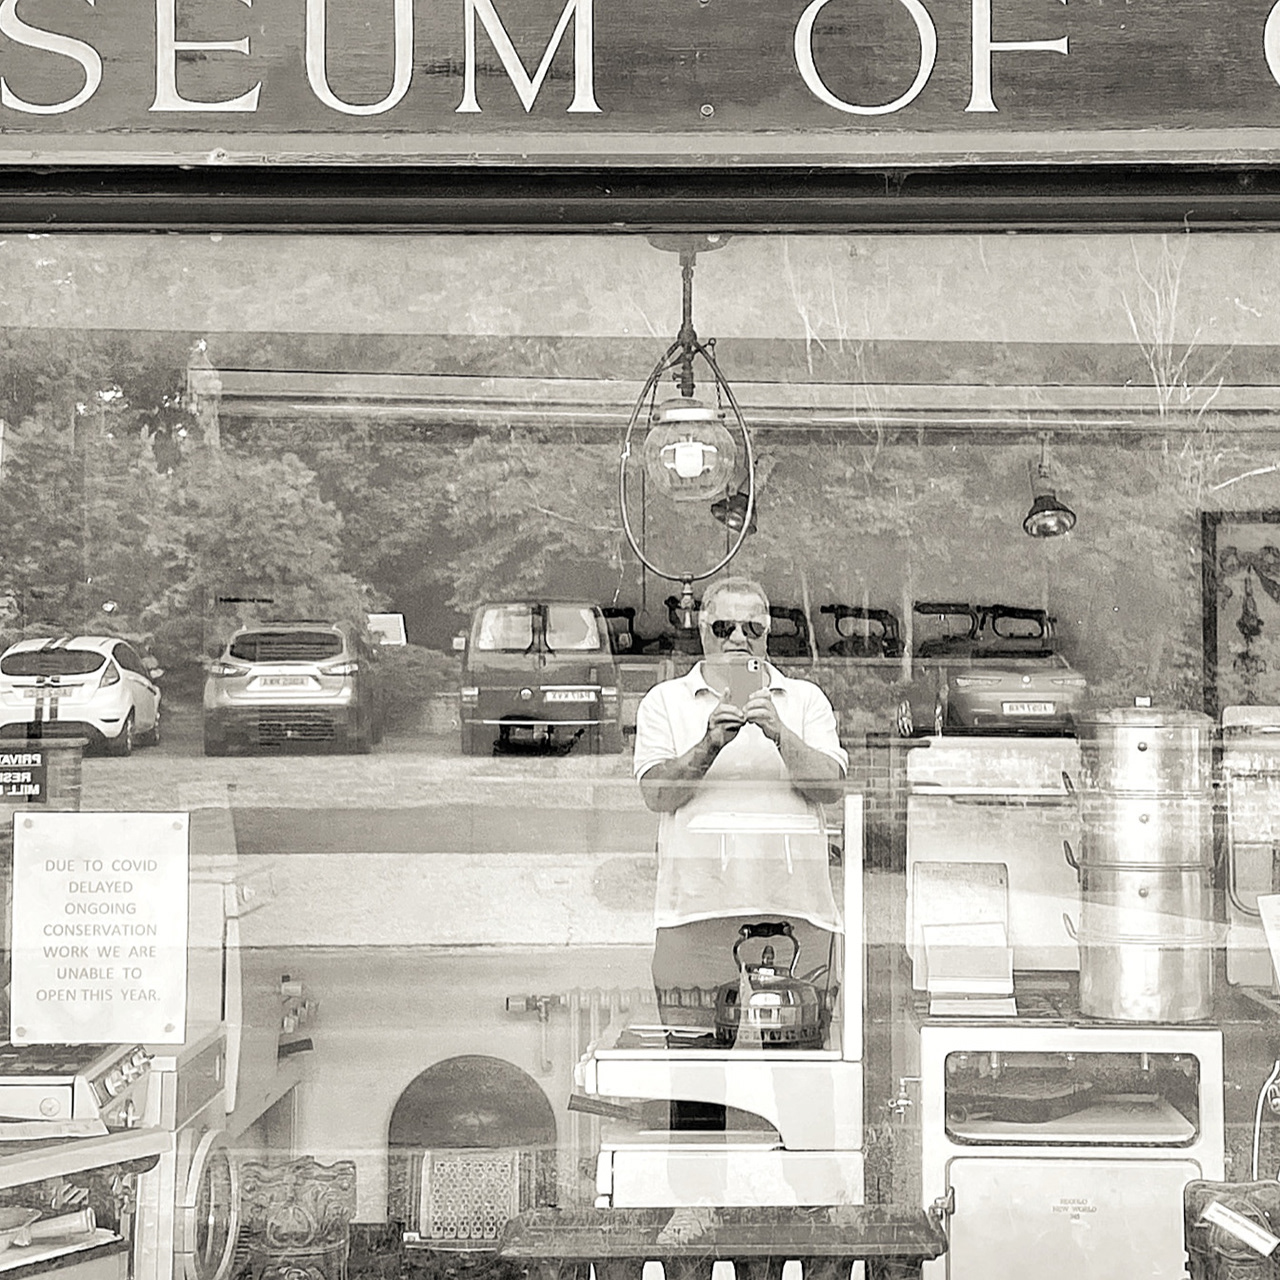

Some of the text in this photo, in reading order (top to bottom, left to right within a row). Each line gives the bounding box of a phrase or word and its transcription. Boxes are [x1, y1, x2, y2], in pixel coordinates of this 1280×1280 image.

[45, 860, 157, 872] DUE TO COVID
[69, 881, 133, 893] DELAYED
[64, 903, 136, 915] ONGOING
[43, 925, 157, 936] CONSERVATION
[43, 946, 156, 958] WORK WE ARE
[57, 968, 142, 979] UNABLE TO
[36, 990, 160, 1001] OPEN THIS YEAR.
